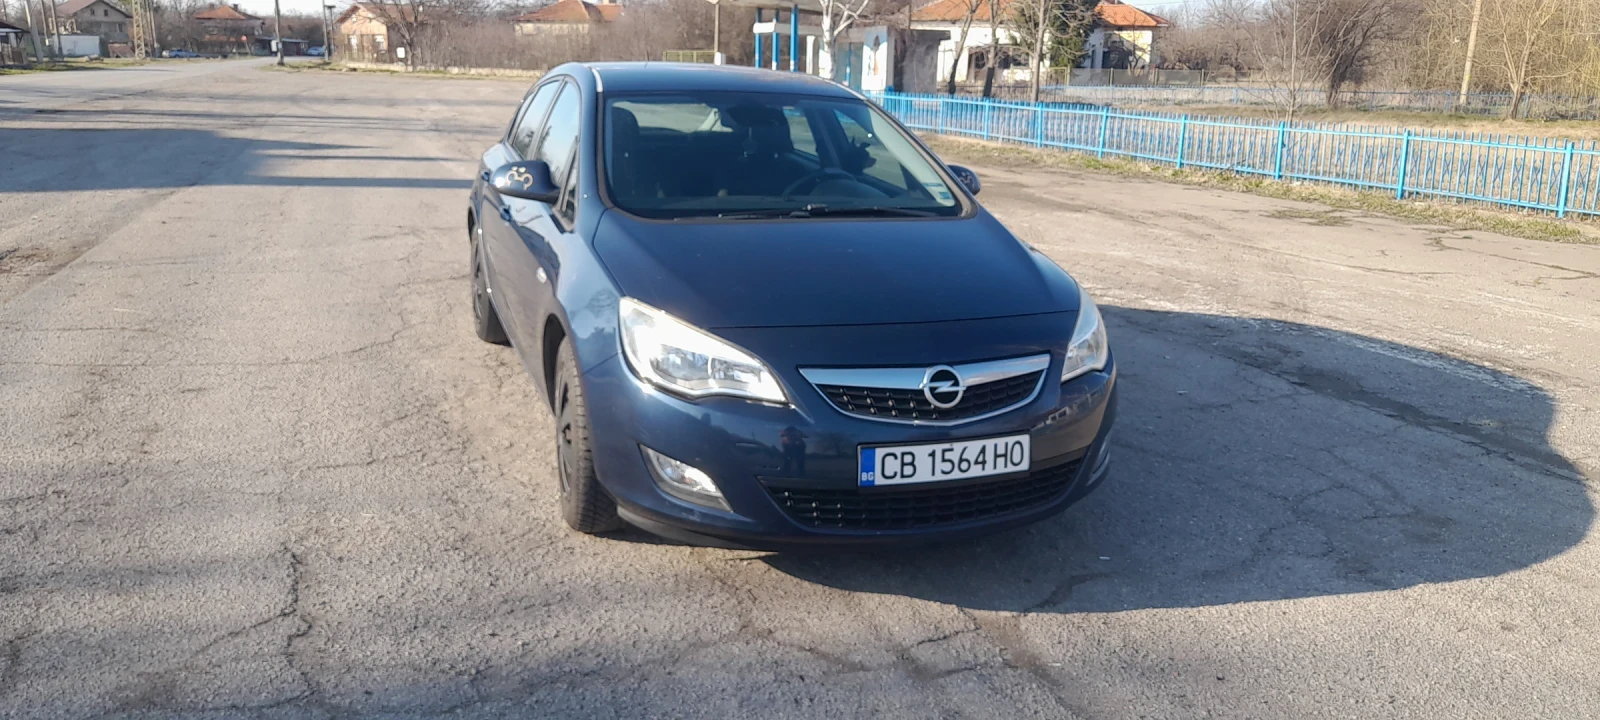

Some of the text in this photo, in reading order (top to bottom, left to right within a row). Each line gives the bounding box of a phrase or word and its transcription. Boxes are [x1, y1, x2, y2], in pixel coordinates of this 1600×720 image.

[881, 440, 1024, 480] CB 1564 HO
[862, 472, 874, 481] BG
